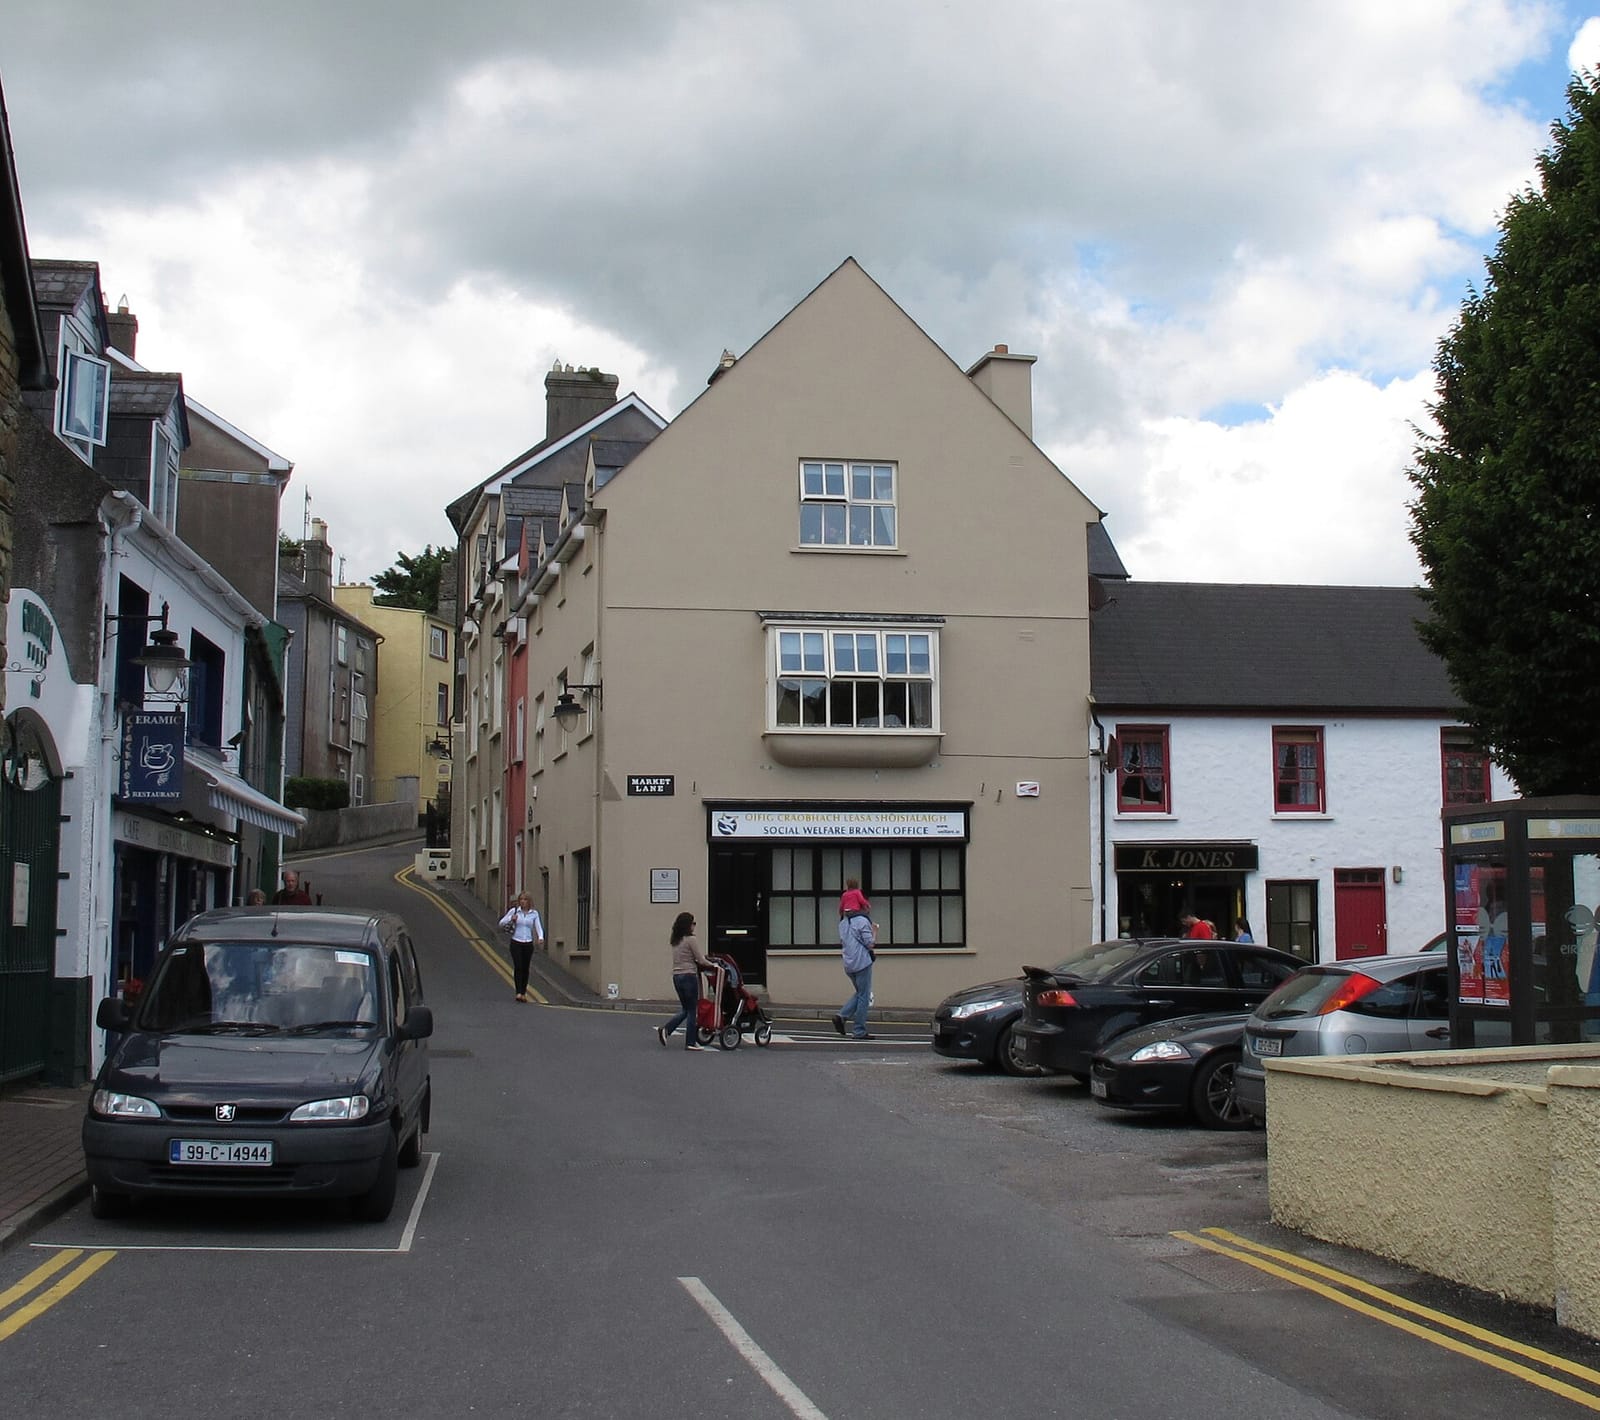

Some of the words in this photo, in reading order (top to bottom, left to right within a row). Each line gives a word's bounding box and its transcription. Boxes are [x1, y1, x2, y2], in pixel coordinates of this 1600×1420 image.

[745, 813, 774, 822] OIFIG
[777, 813, 840, 822] CRAOBHACH
[844, 813, 872, 822] LEASA
[763, 826, 800, 835] SOCIAL
[803, 826, 846, 835] WELFARE
[849, 826, 890, 835] BRANCH
[892, 826, 929, 835] OFFICE
[1140, 849, 1161, 868] K.
[1167, 849, 1235, 868] JONES
[187, 1145, 267, 1161] 99-C-14944
